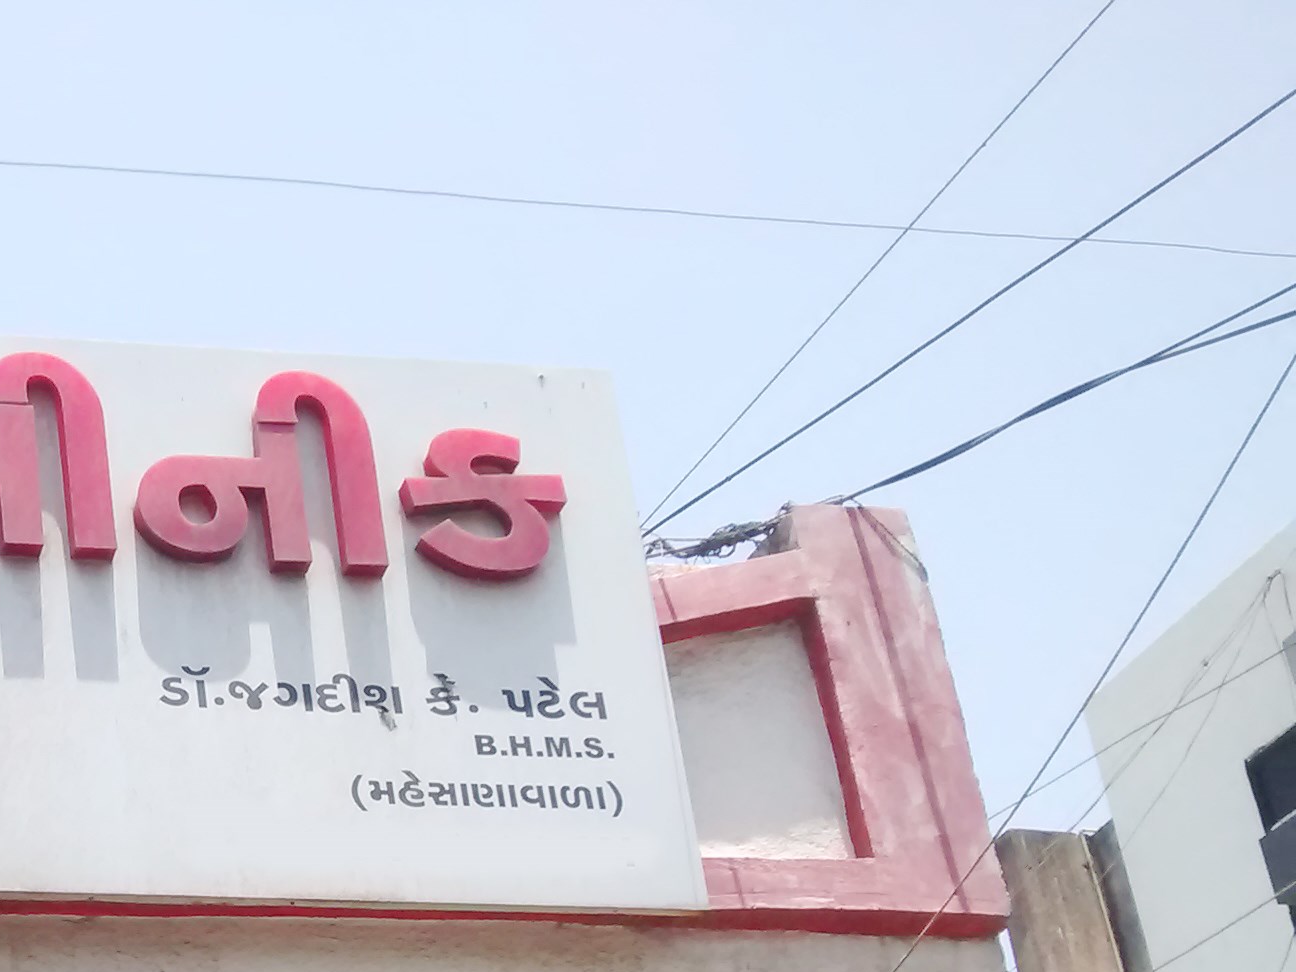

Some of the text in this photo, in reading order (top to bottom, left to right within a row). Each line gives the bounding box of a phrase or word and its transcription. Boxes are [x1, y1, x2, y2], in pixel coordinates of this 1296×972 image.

[502, 677, 608, 720] પટેલ
[474, 734, 615, 760] B.H.M.S.
[350, 770, 624, 818] (મહેસાણાવાળા)
